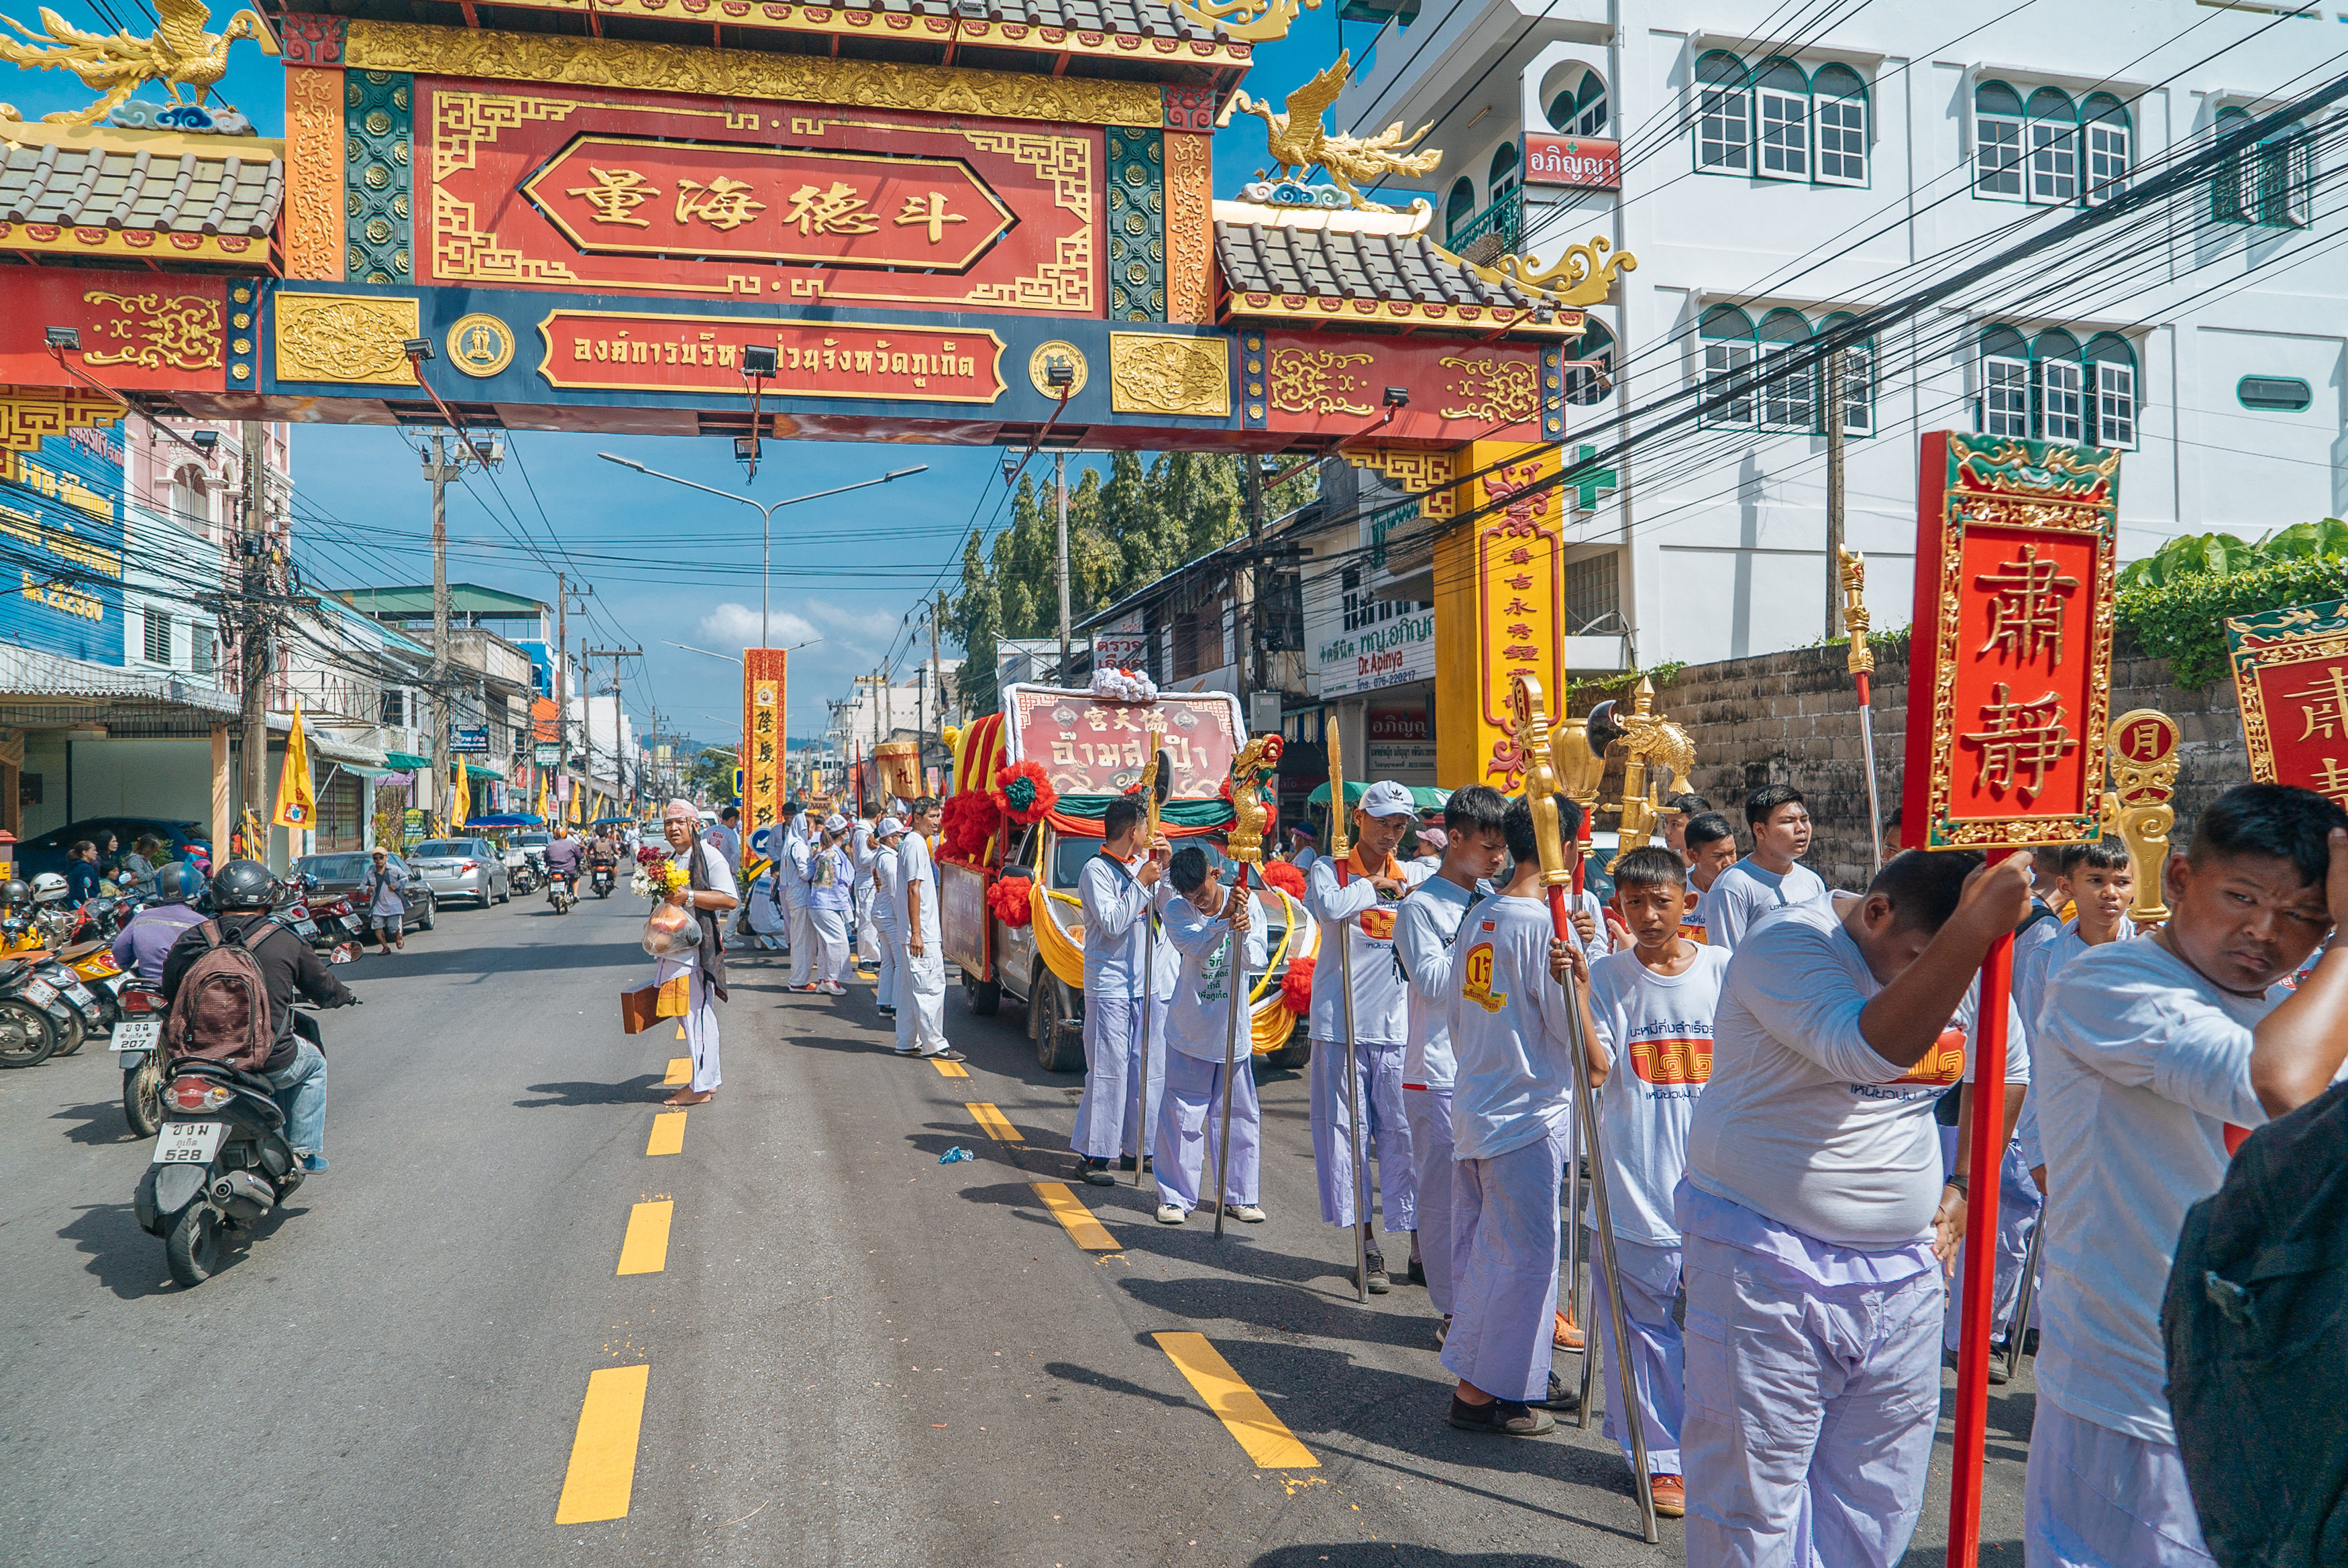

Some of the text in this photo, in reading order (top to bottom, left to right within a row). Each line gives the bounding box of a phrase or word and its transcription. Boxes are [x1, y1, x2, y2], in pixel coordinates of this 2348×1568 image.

[1530, 145, 1615, 182] อภิญญา
[1358, 649, 1403, 677] Dr. Apinya
[1373, 670, 1416, 688] 076-220217
[2129, 723, 2159, 759] 月
[164, 1150, 203, 1161] 528
